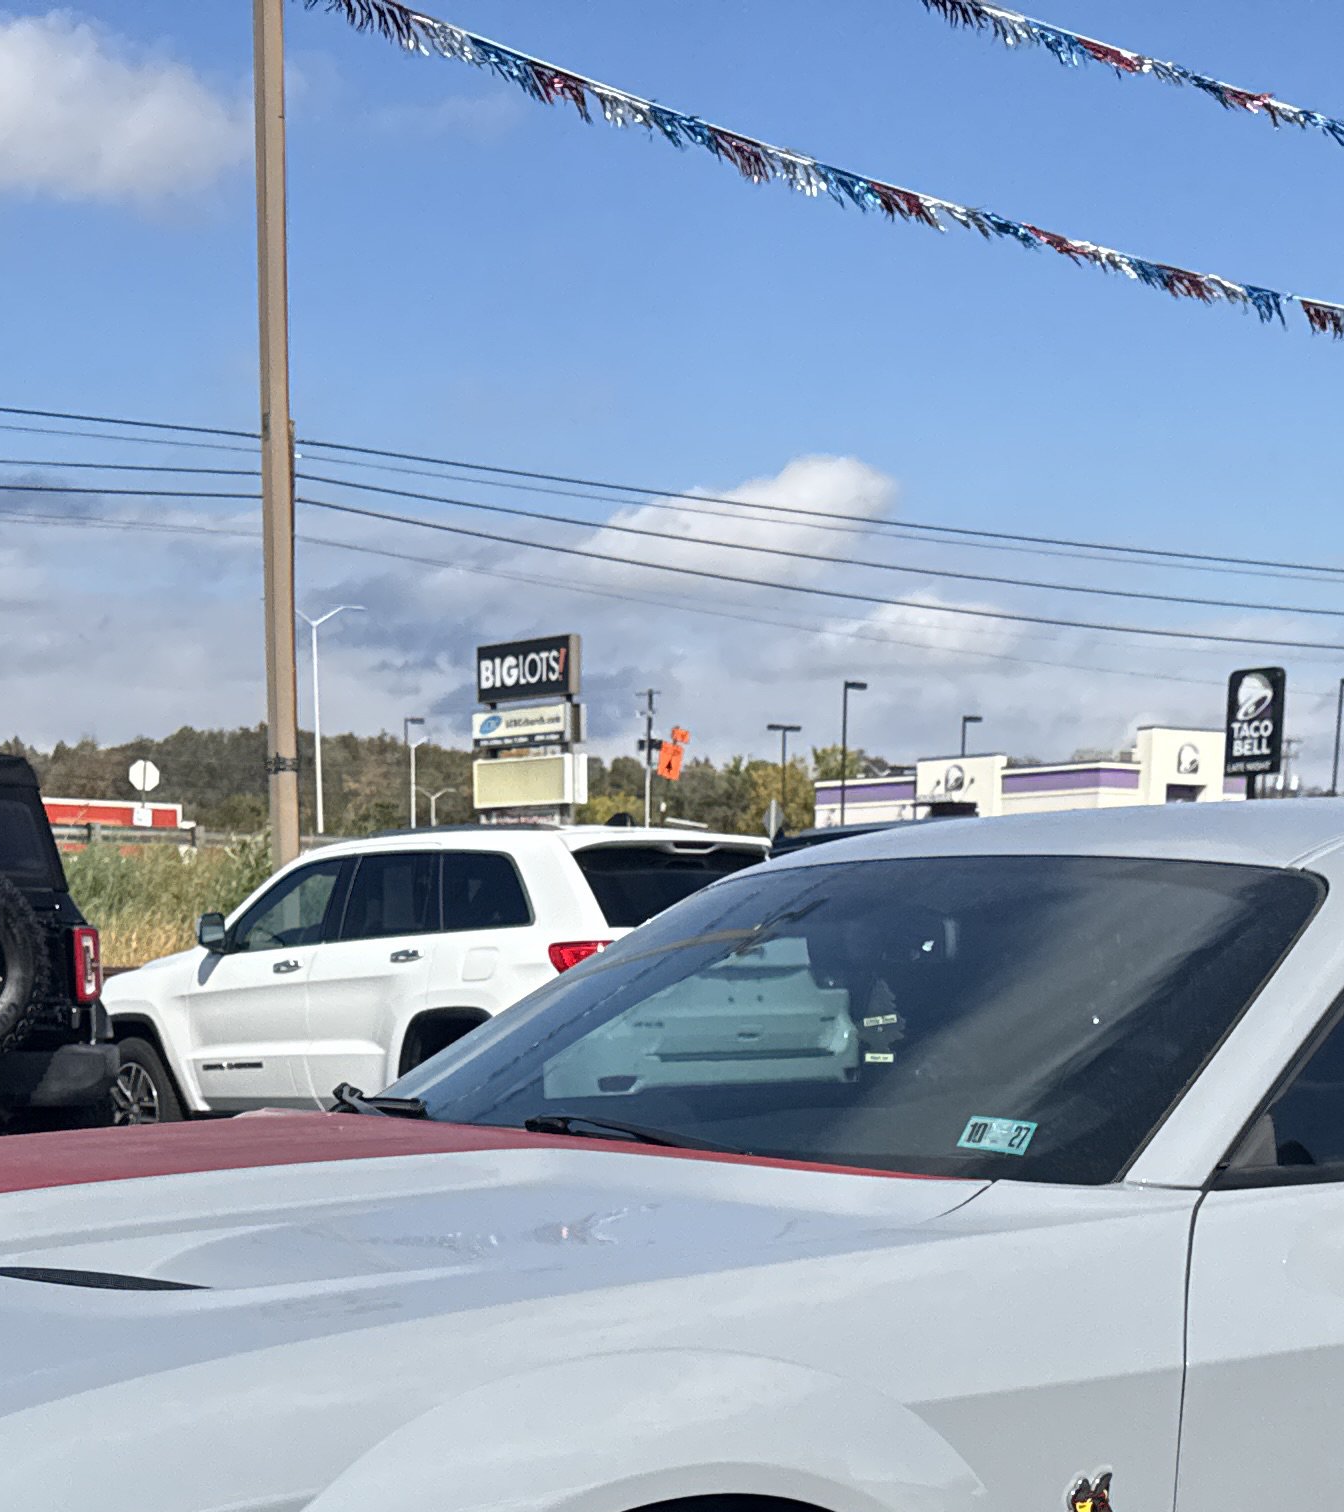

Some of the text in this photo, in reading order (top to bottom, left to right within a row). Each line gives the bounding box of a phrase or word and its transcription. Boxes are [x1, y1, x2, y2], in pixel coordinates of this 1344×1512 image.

[1230, 718, 1274, 740] TACO
[1231, 737, 1272, 757] BELL
[965, 1122, 1032, 1149] 10 27
